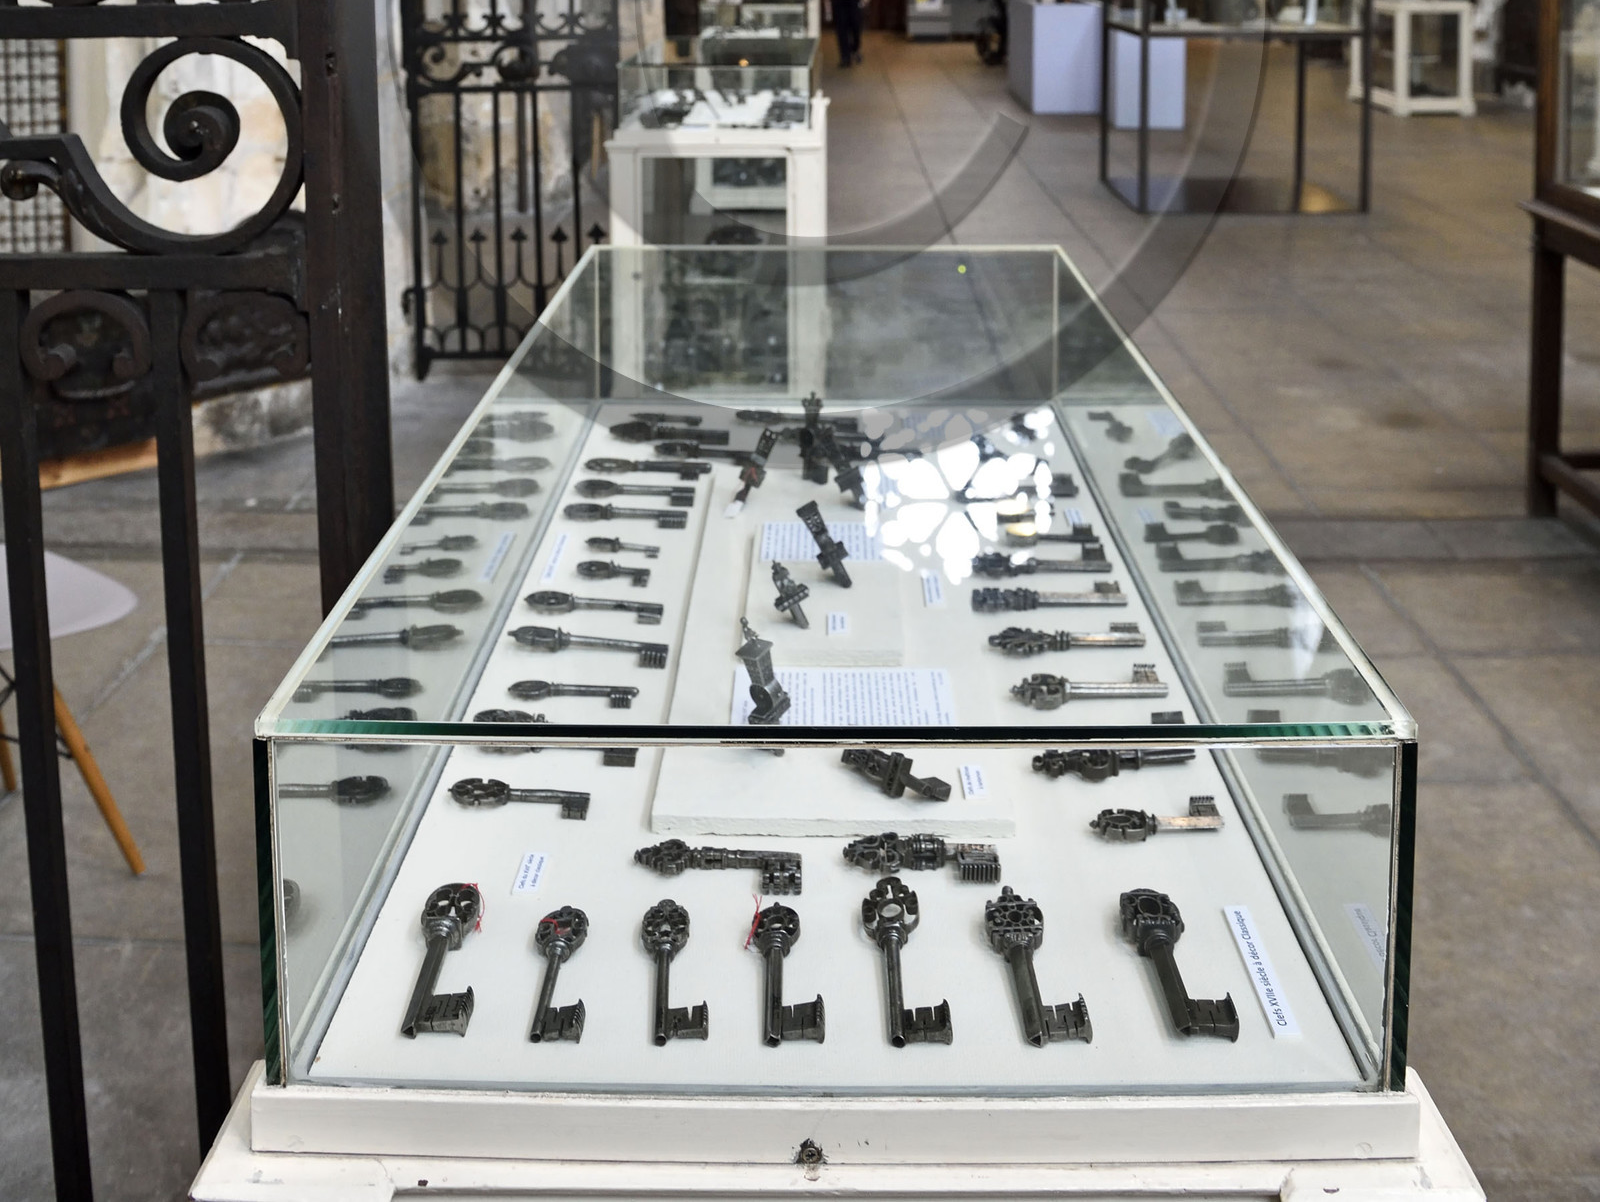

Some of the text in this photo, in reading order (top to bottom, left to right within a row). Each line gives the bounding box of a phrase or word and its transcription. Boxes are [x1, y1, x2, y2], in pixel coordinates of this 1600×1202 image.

[1234, 910, 1251, 940] Classique
[1246, 941, 1260, 960] décor
[1256, 966, 1272, 987] siècle
[1265, 988, 1280, 1008] XVIIe
[1273, 1008, 1287, 1026] Clefs
